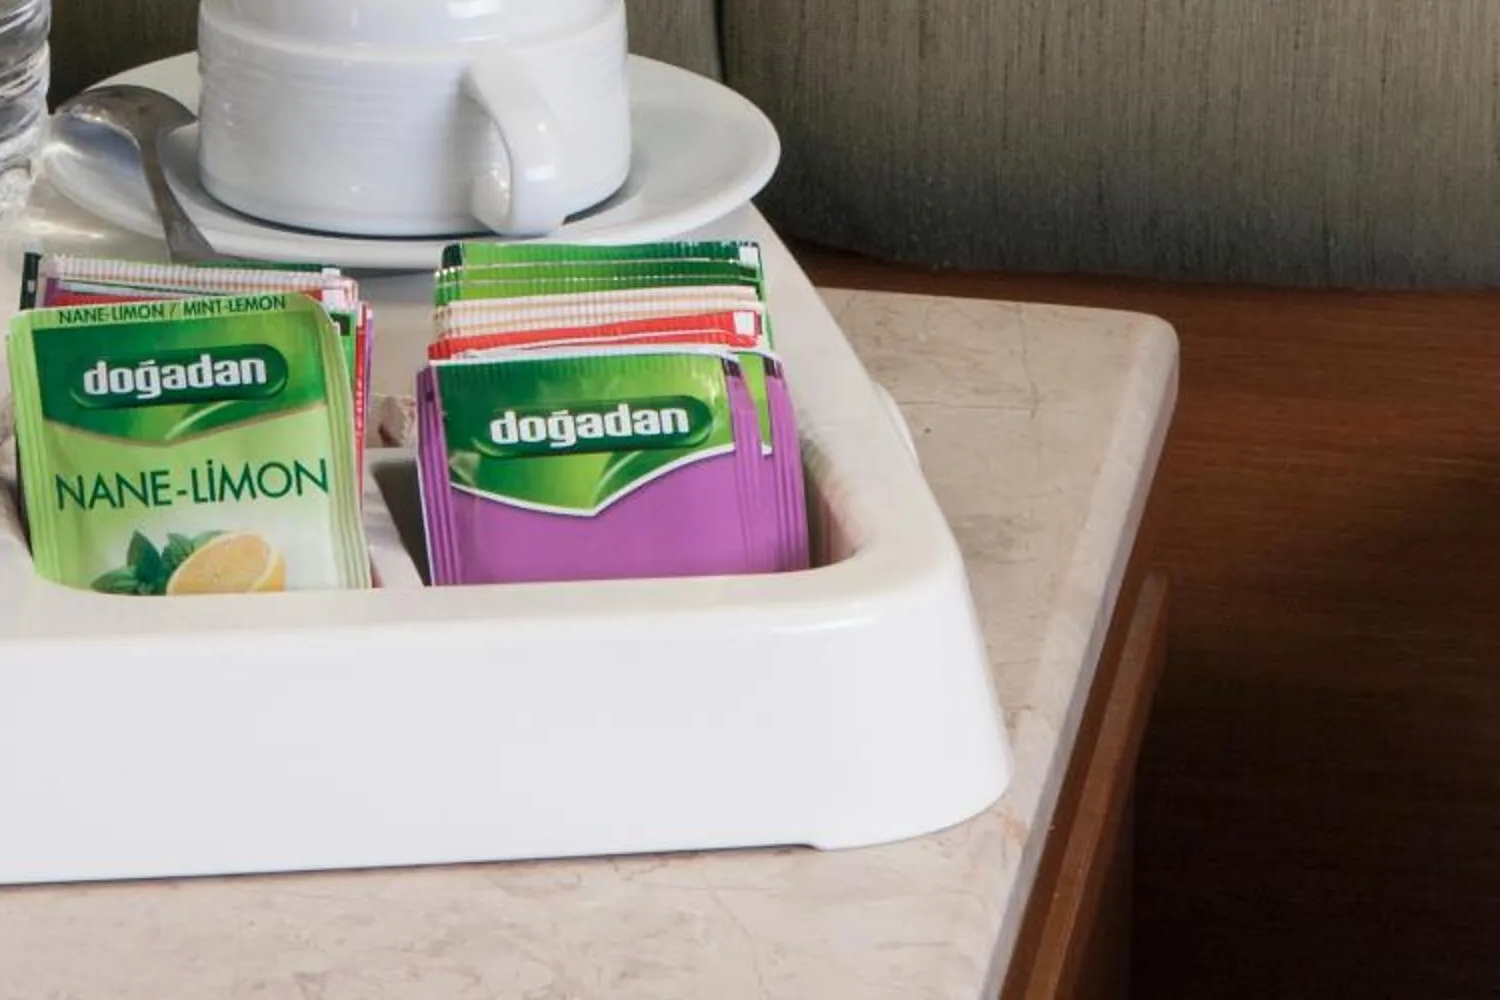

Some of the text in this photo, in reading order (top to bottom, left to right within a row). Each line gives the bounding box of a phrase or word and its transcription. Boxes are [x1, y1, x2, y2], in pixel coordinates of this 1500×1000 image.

[83, 354, 267, 400] doğadan
[490, 404, 690, 448] doğadan
[55, 458, 329, 511] NANE-LİMON
